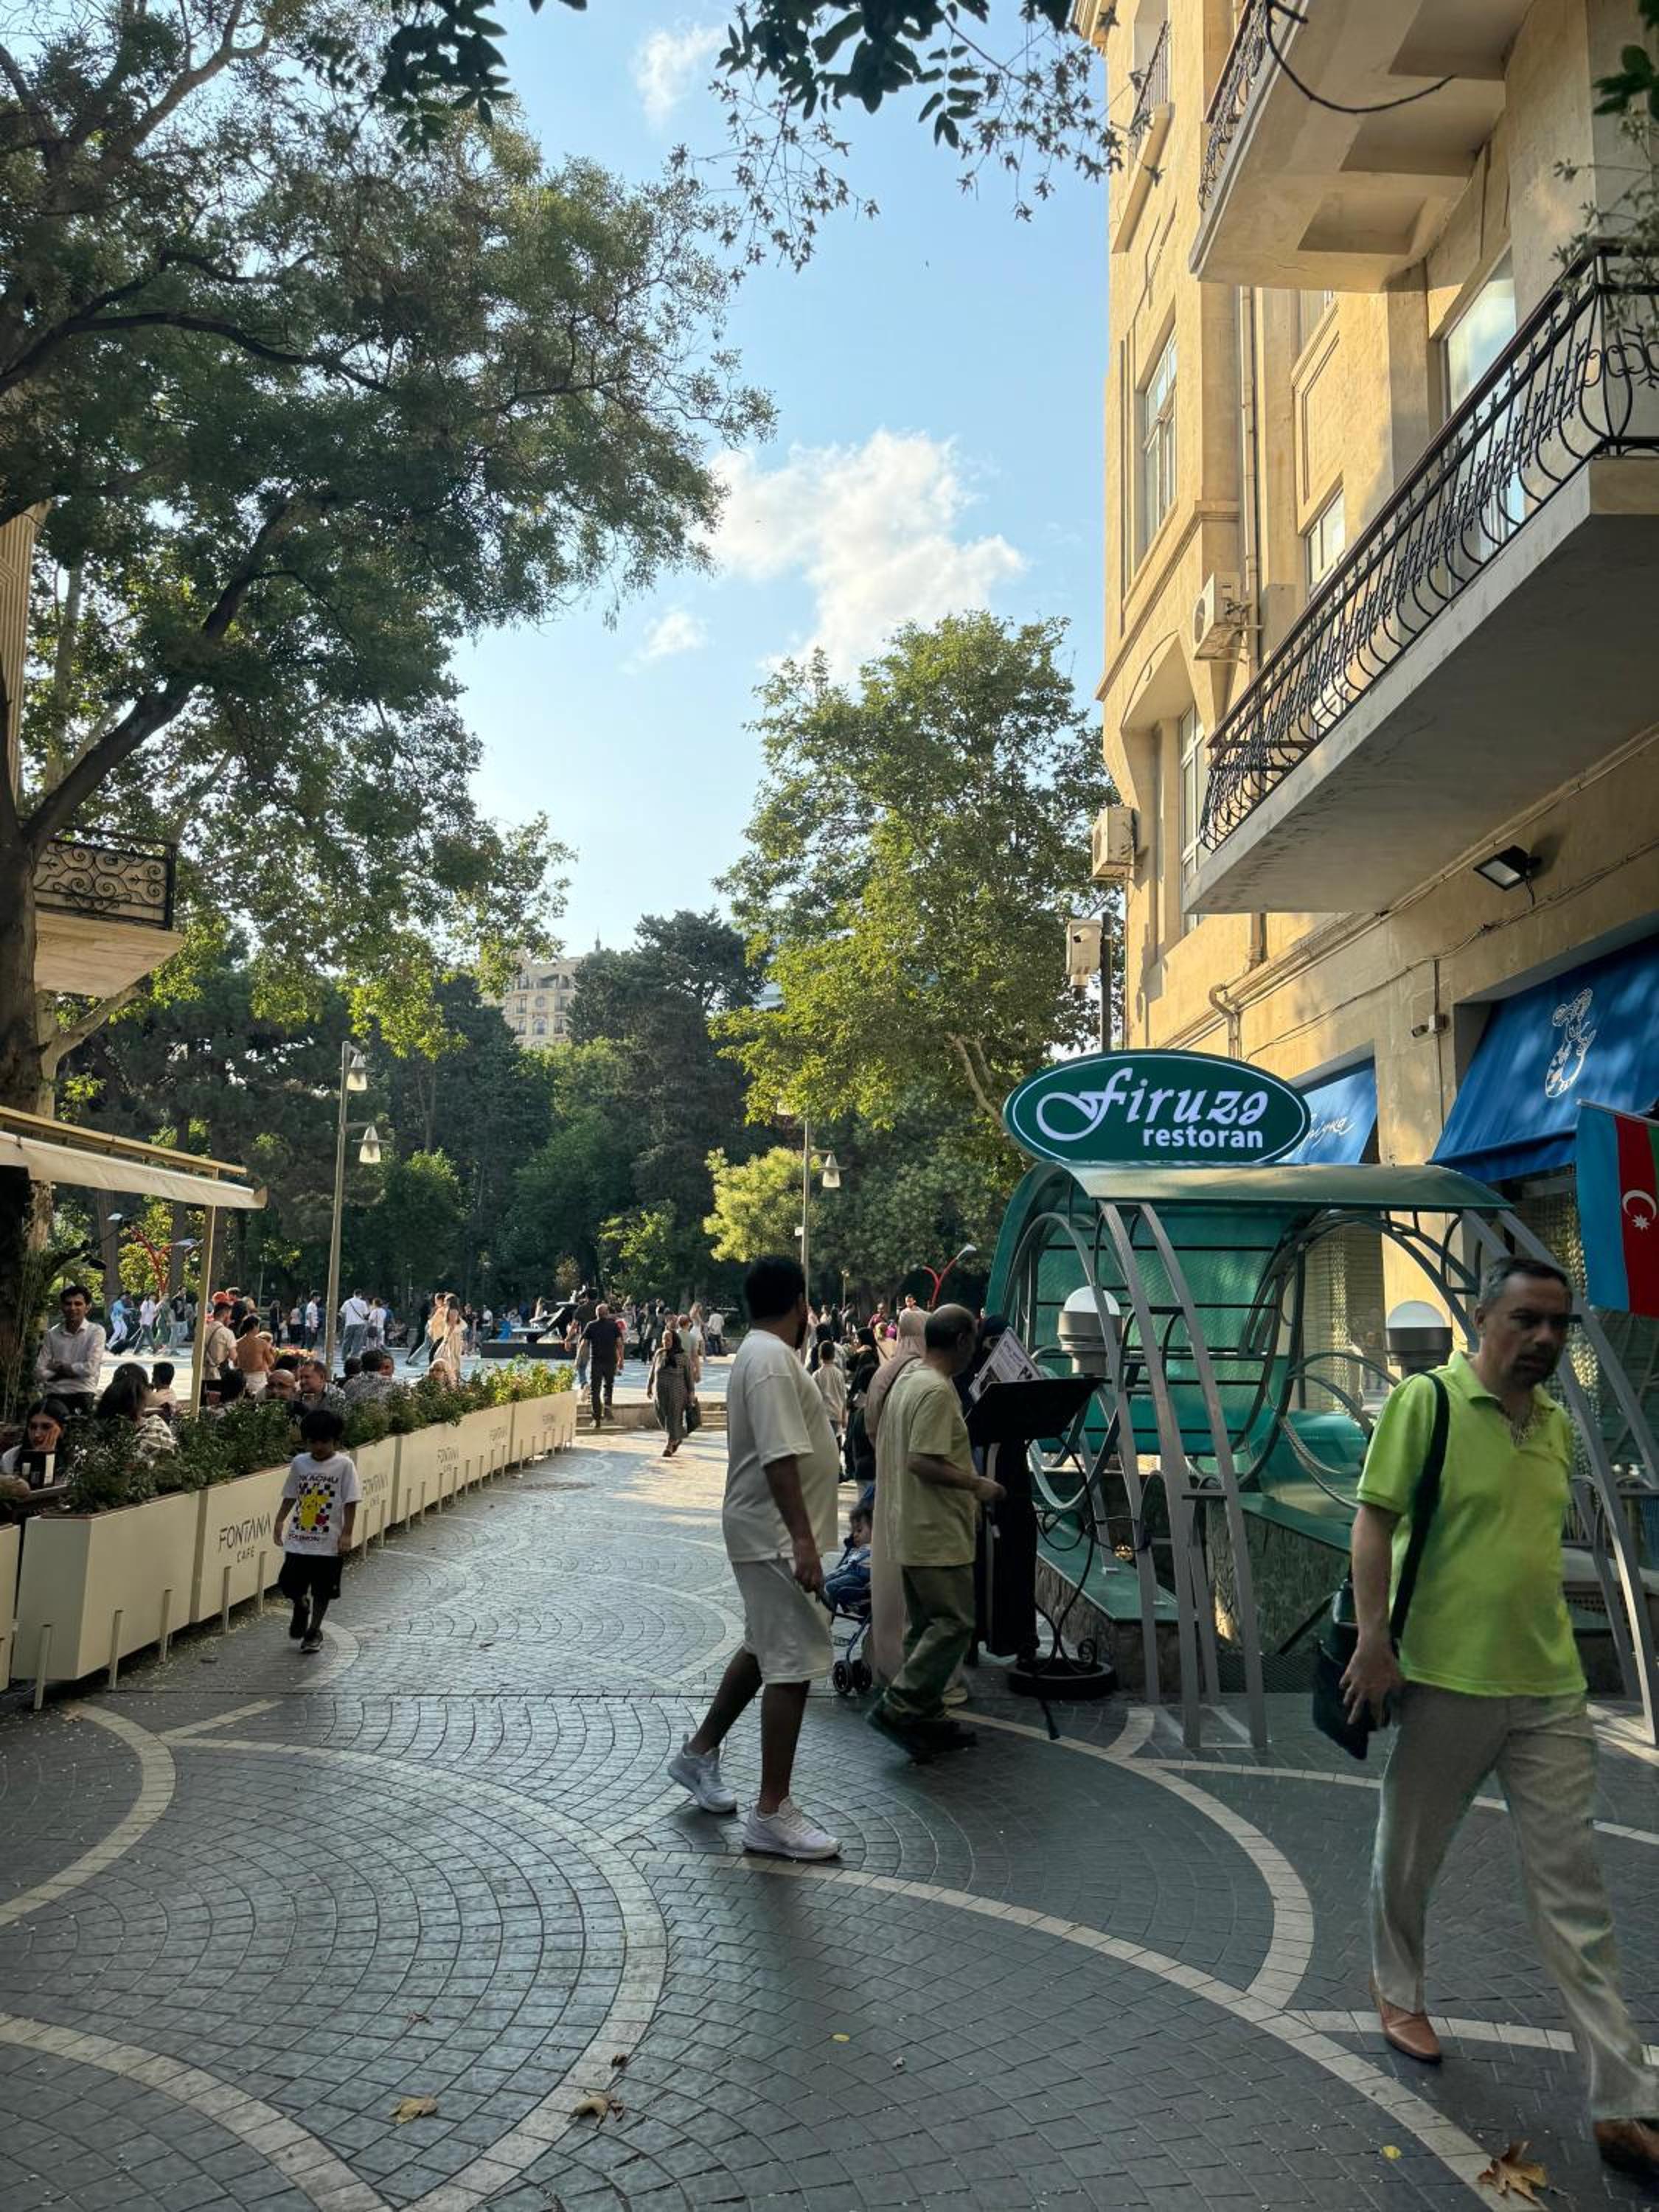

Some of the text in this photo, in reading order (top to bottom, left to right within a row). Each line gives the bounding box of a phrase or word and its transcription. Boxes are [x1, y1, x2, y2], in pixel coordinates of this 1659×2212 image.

[1036, 1067, 1269, 1142] Firuzə
[1143, 1124, 1263, 1148] restoran
[218, 1512, 271, 1554] FONTANA
